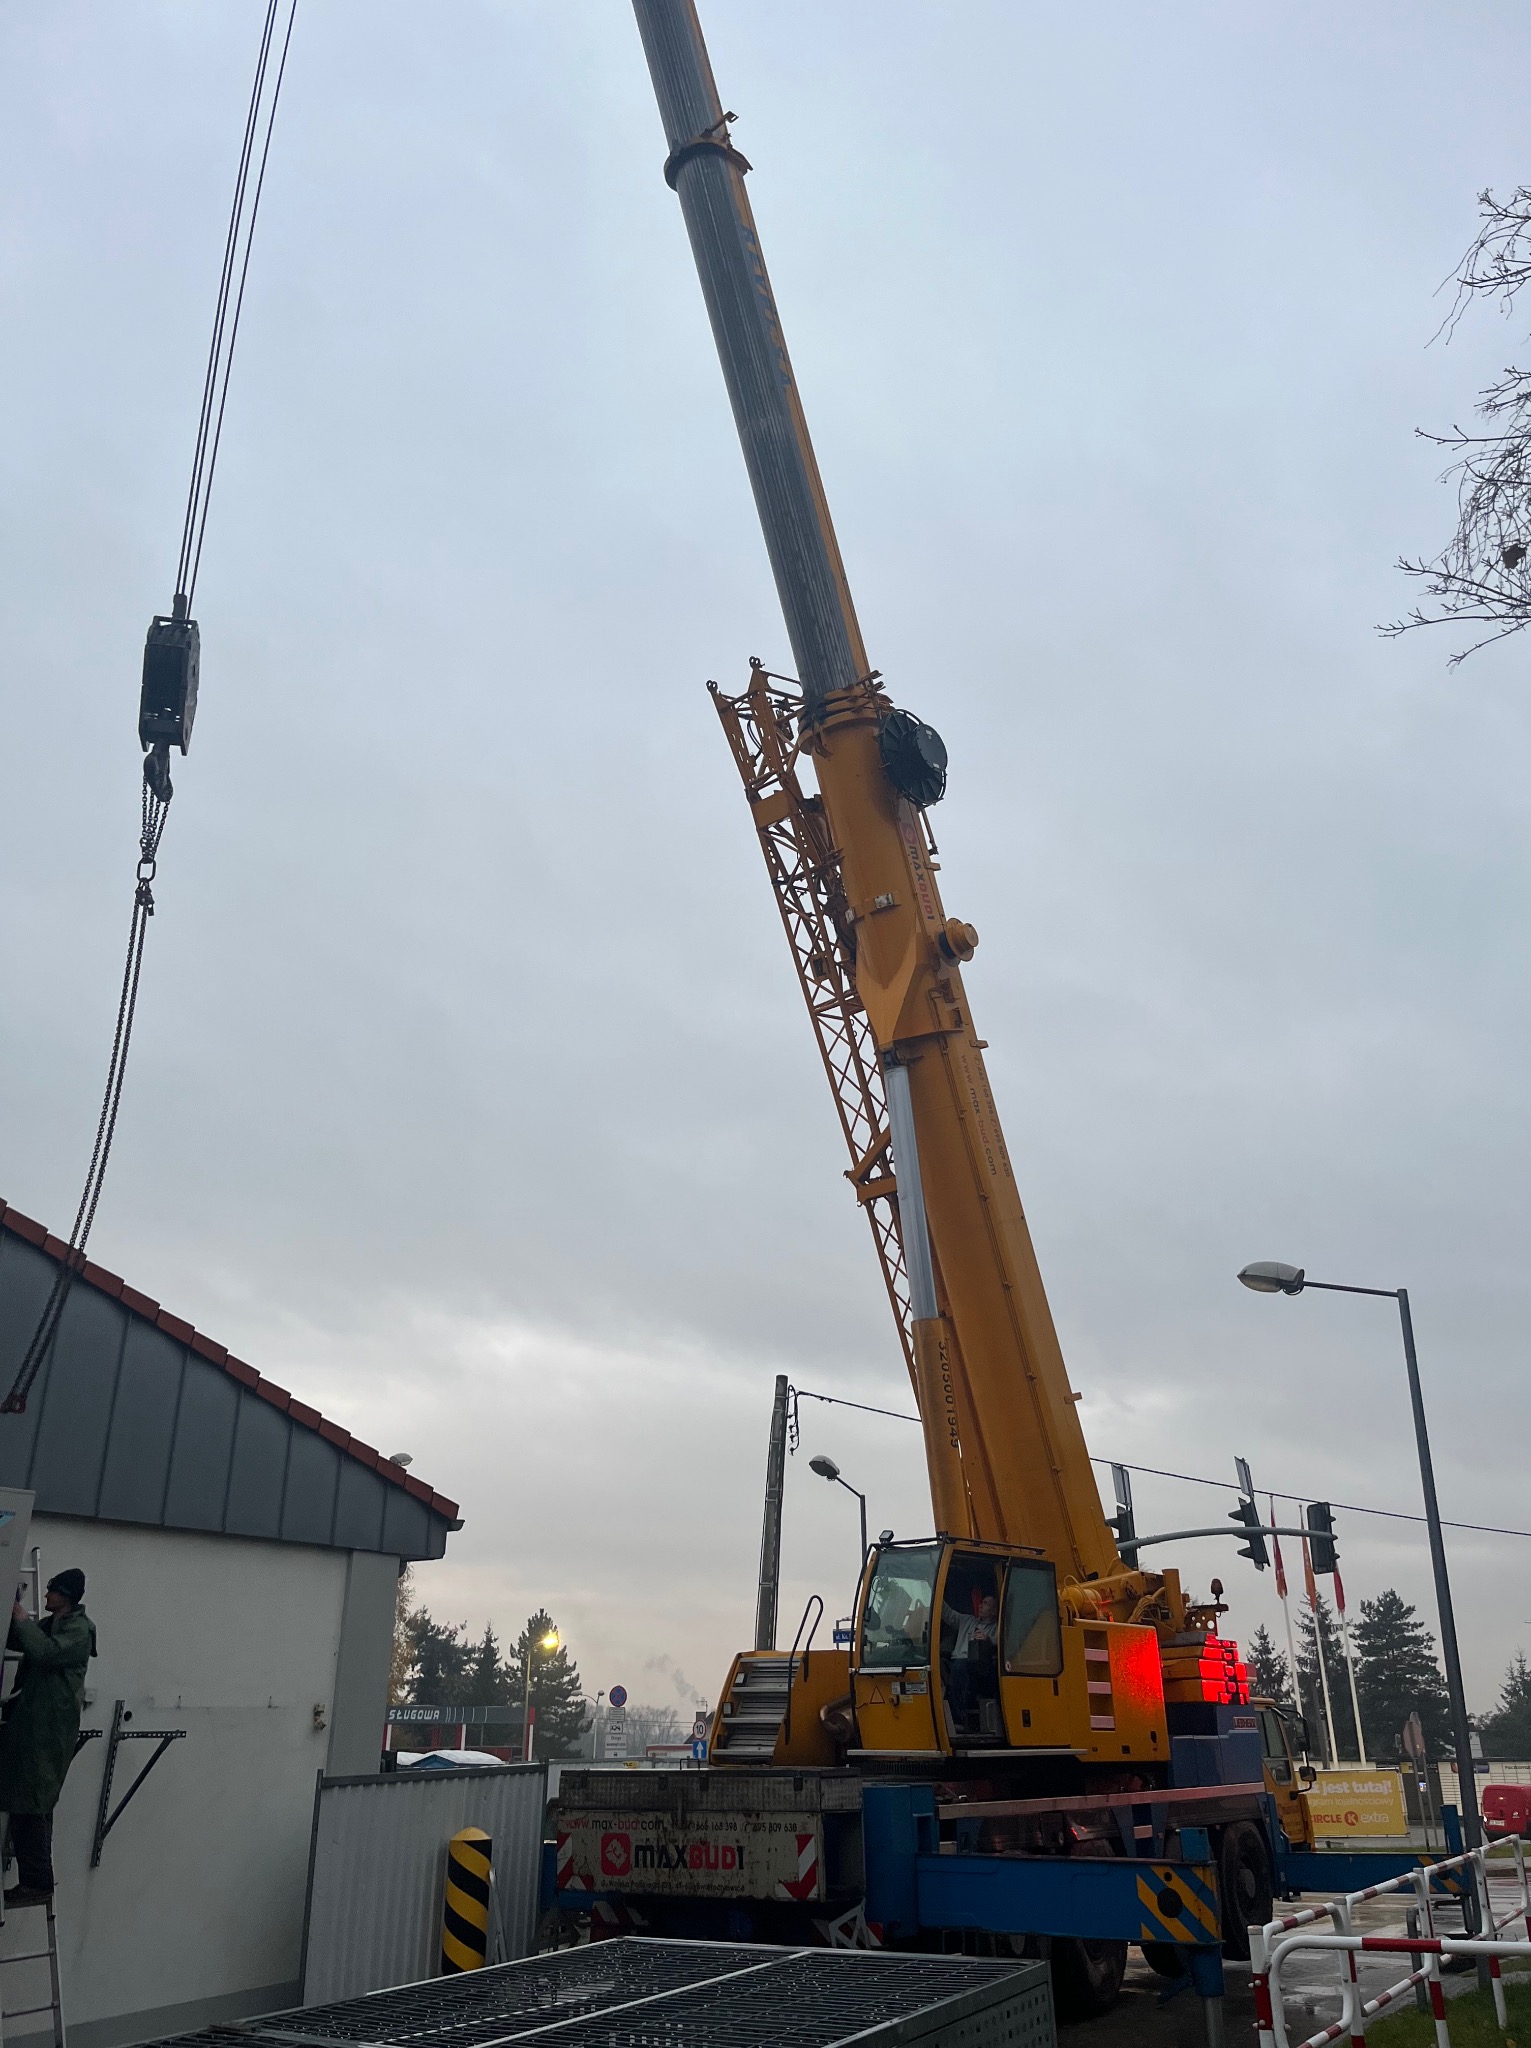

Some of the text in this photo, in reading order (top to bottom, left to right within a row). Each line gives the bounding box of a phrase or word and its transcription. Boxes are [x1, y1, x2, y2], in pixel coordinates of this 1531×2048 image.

[961, 1054, 997, 1176] www.max-bud.com
[938, 1340, 960, 1449] 3205001949
[696, 1724, 704, 1735] 10
[1322, 1780, 1351, 1796] jest
[1352, 1780, 1393, 1796] tutaj!
[1361, 1811, 1389, 1824] extra
